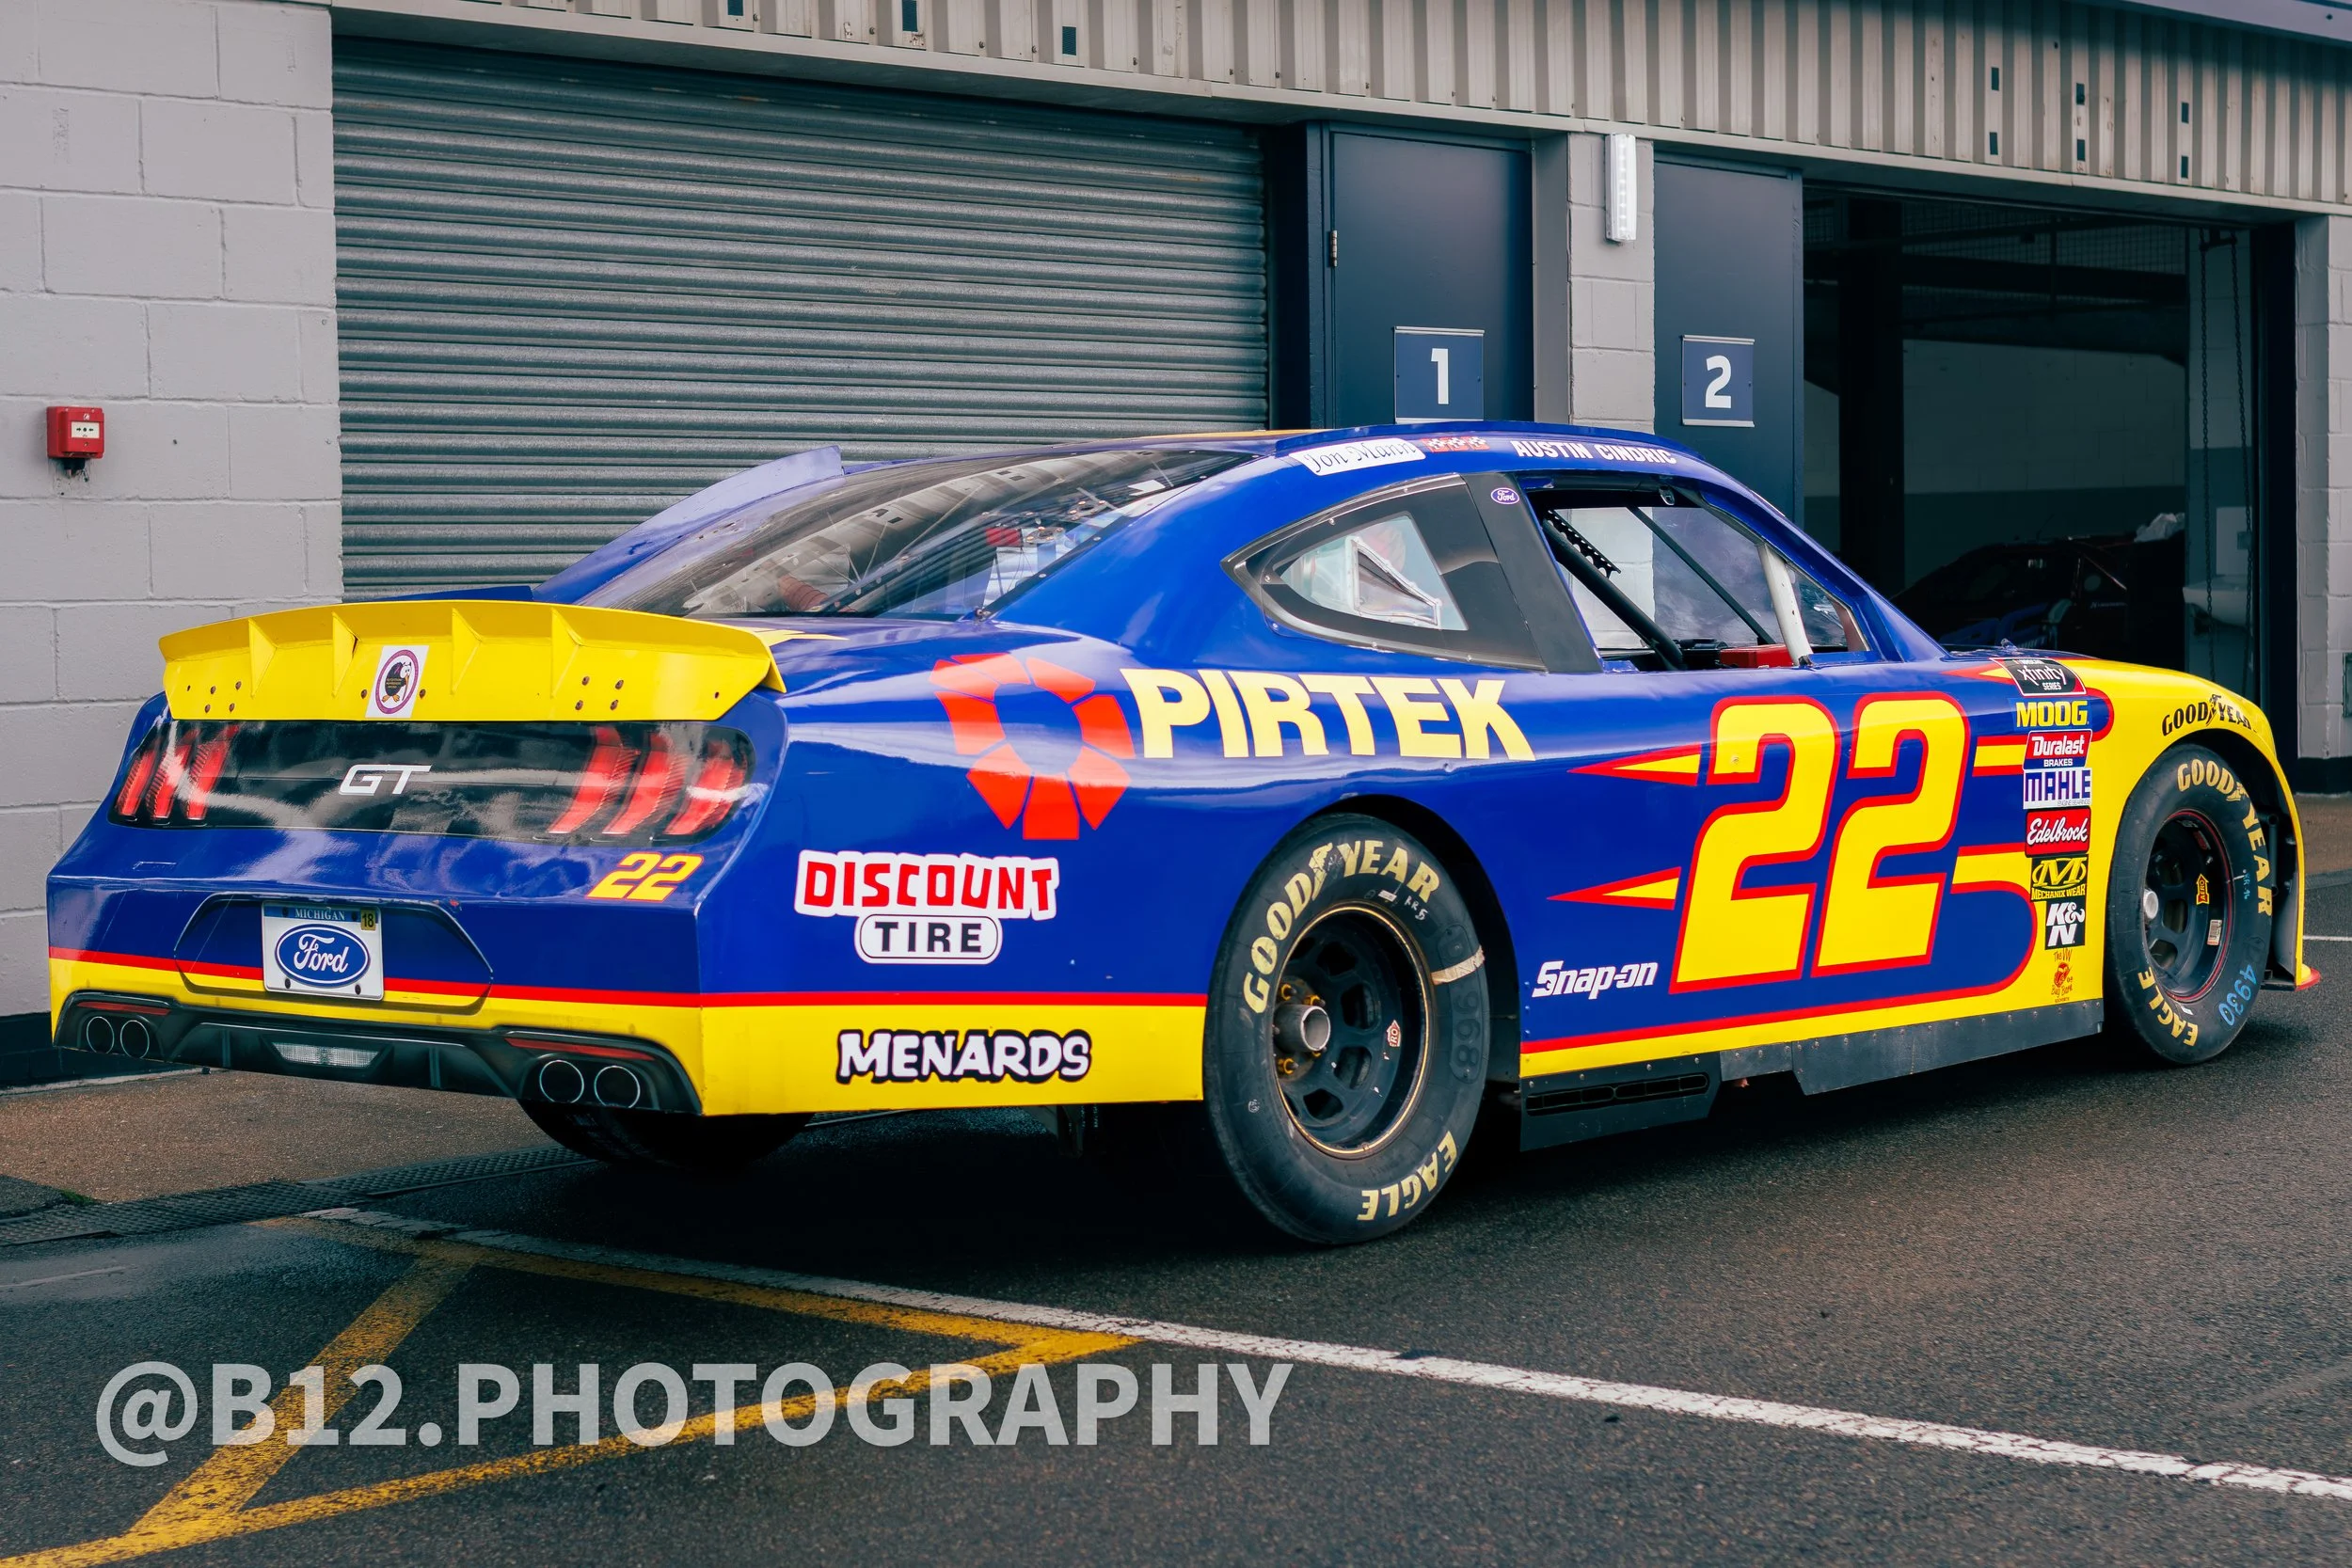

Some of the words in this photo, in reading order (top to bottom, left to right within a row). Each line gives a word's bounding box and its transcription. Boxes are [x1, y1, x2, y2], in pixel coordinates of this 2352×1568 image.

[1430, 347, 1450, 405] 1
[1705, 355, 1732, 409] 2
[1510, 440, 1593, 459] AUSTIN
[1594, 444, 1677, 464] CINDRIC
[1497, 489, 1516, 502] Ford
[2042, 682, 2062, 690] SERIES
[1119, 668, 1536, 761] PIRTEK
[2015, 700, 2089, 728] MOOG
[2031, 735, 2085, 756] Duralast
[2043, 758, 2074, 768] BRAKES
[339, 764, 432, 797] GT
[2025, 769, 2091, 802] MAHLE
[1668, 690, 1971, 995] 22
[2026, 816, 2089, 846] Edelbrock
[584, 851, 704, 903] 22
[803, 860, 1053, 912] DISCOUNT
[2030, 887, 2066, 900] MECHANIX
[2066, 884, 2086, 897] WEAR
[294, 909, 345, 921] MICHIGAN
[361, 913, 374, 927] 18
[294, 933, 349, 974] Ford
[874, 921, 982, 953] TIRE
[1532, 960, 1659, 1000] Snap-on
[2218, 964, 2257, 1026] 4930
[2137, 966, 2199, 1047] EAGLE
[836, 1030, 1091, 1083] MENARDS
[1356, 1131, 1458, 1221] EAGLE
